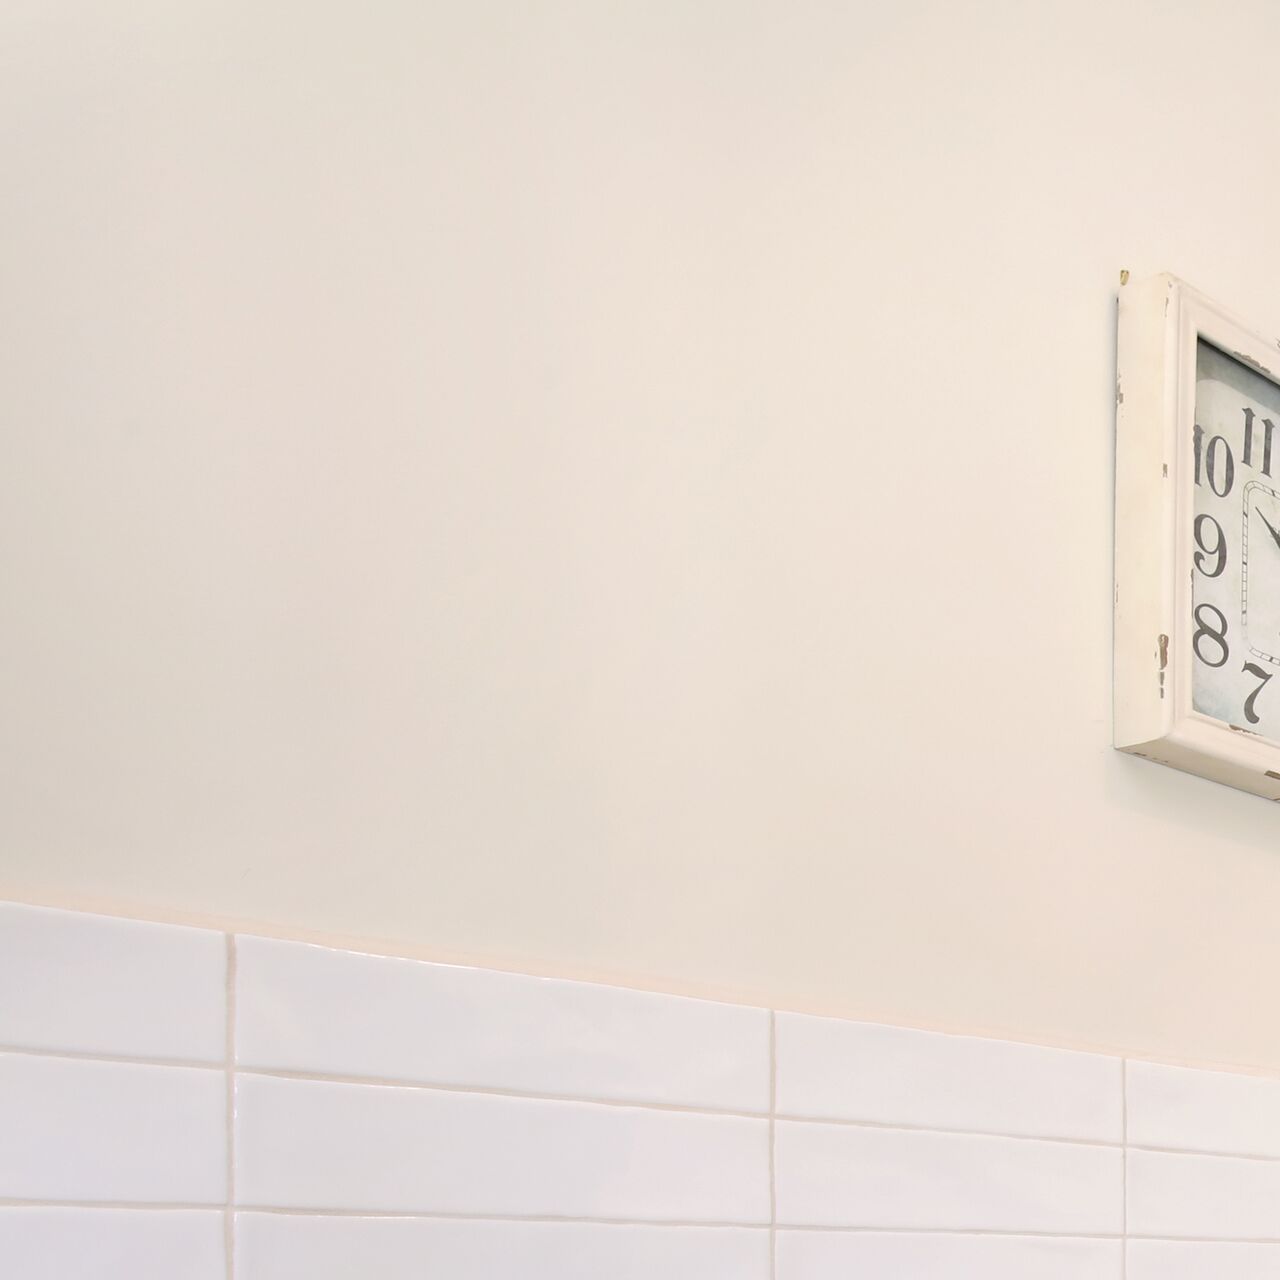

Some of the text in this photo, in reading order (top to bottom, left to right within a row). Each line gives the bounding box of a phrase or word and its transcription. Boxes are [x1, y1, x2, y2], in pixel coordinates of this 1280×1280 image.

[1193, 424, 1235, 499] 10
[1241, 407, 1275, 478] 11
[1193, 513, 1227, 579] 9
[1192, 603, 1230, 668] 8
[1241, 660, 1274, 724] 7
